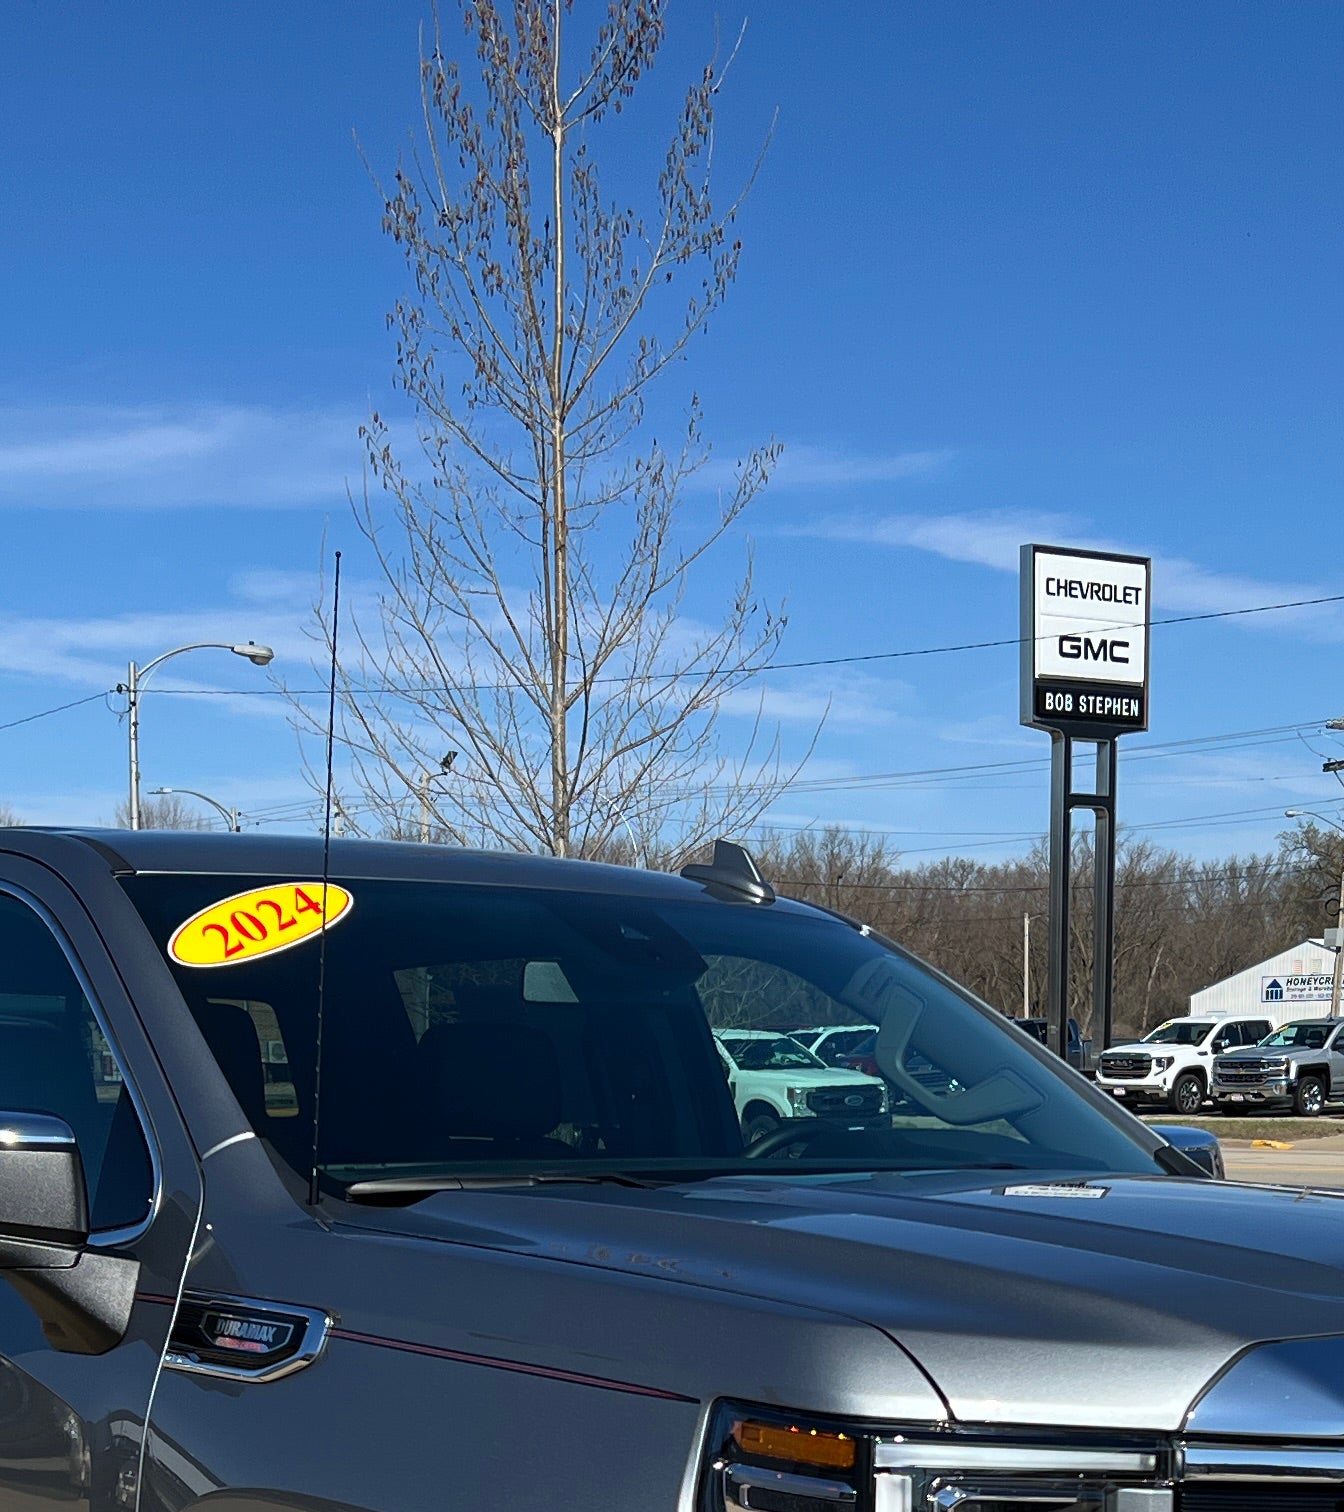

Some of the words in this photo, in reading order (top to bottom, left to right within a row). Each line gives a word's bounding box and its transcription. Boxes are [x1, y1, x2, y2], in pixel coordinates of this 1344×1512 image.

[1046, 577, 1142, 605] CHEVROLET
[1058, 635, 1130, 664] GMC
[1045, 692, 1073, 711] BOB
[1079, 696, 1139, 717] STEPHEN
[202, 887, 323, 958] 2024
[214, 1318, 278, 1342] DURAMAX
